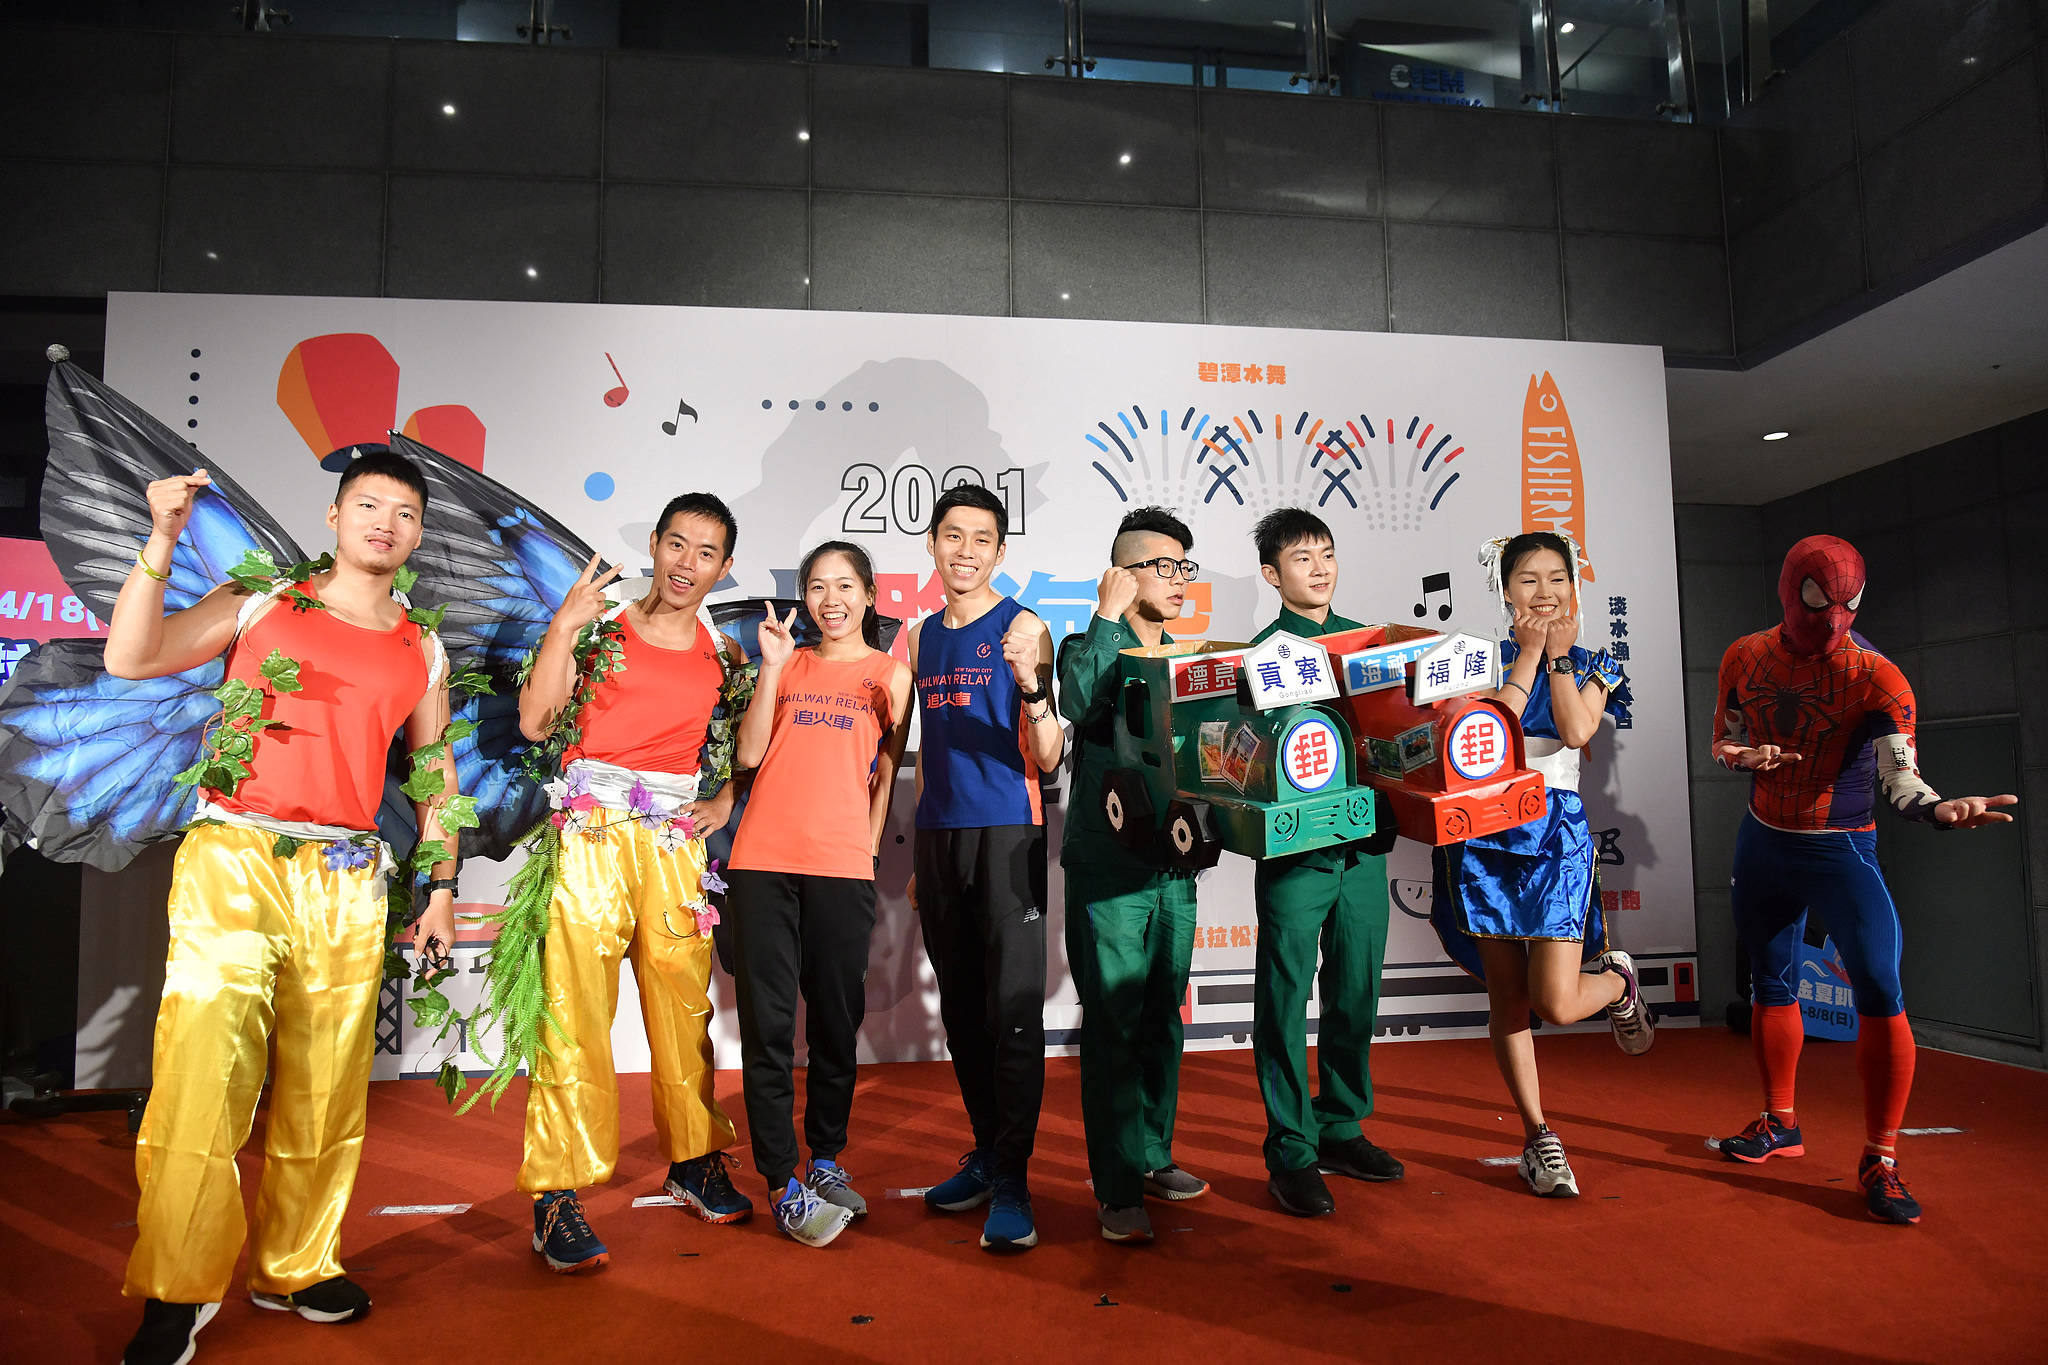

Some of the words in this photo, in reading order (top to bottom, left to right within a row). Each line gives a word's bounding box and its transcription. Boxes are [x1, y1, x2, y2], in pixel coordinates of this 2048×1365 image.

[1198, 362, 1286, 385] 碧潭水舞
[1257, 656, 1322, 692] 貢寮
[1360, 647, 1432, 685] 海神
[1427, 650, 1487, 688] 福隆
[953, 673, 992, 686] RELAY
[778, 693, 832, 706] RAILWAY
[926, 691, 972, 709] 追火車
[793, 709, 854, 731] 追火車
[1193, 925, 1259, 948] 馬拉松
